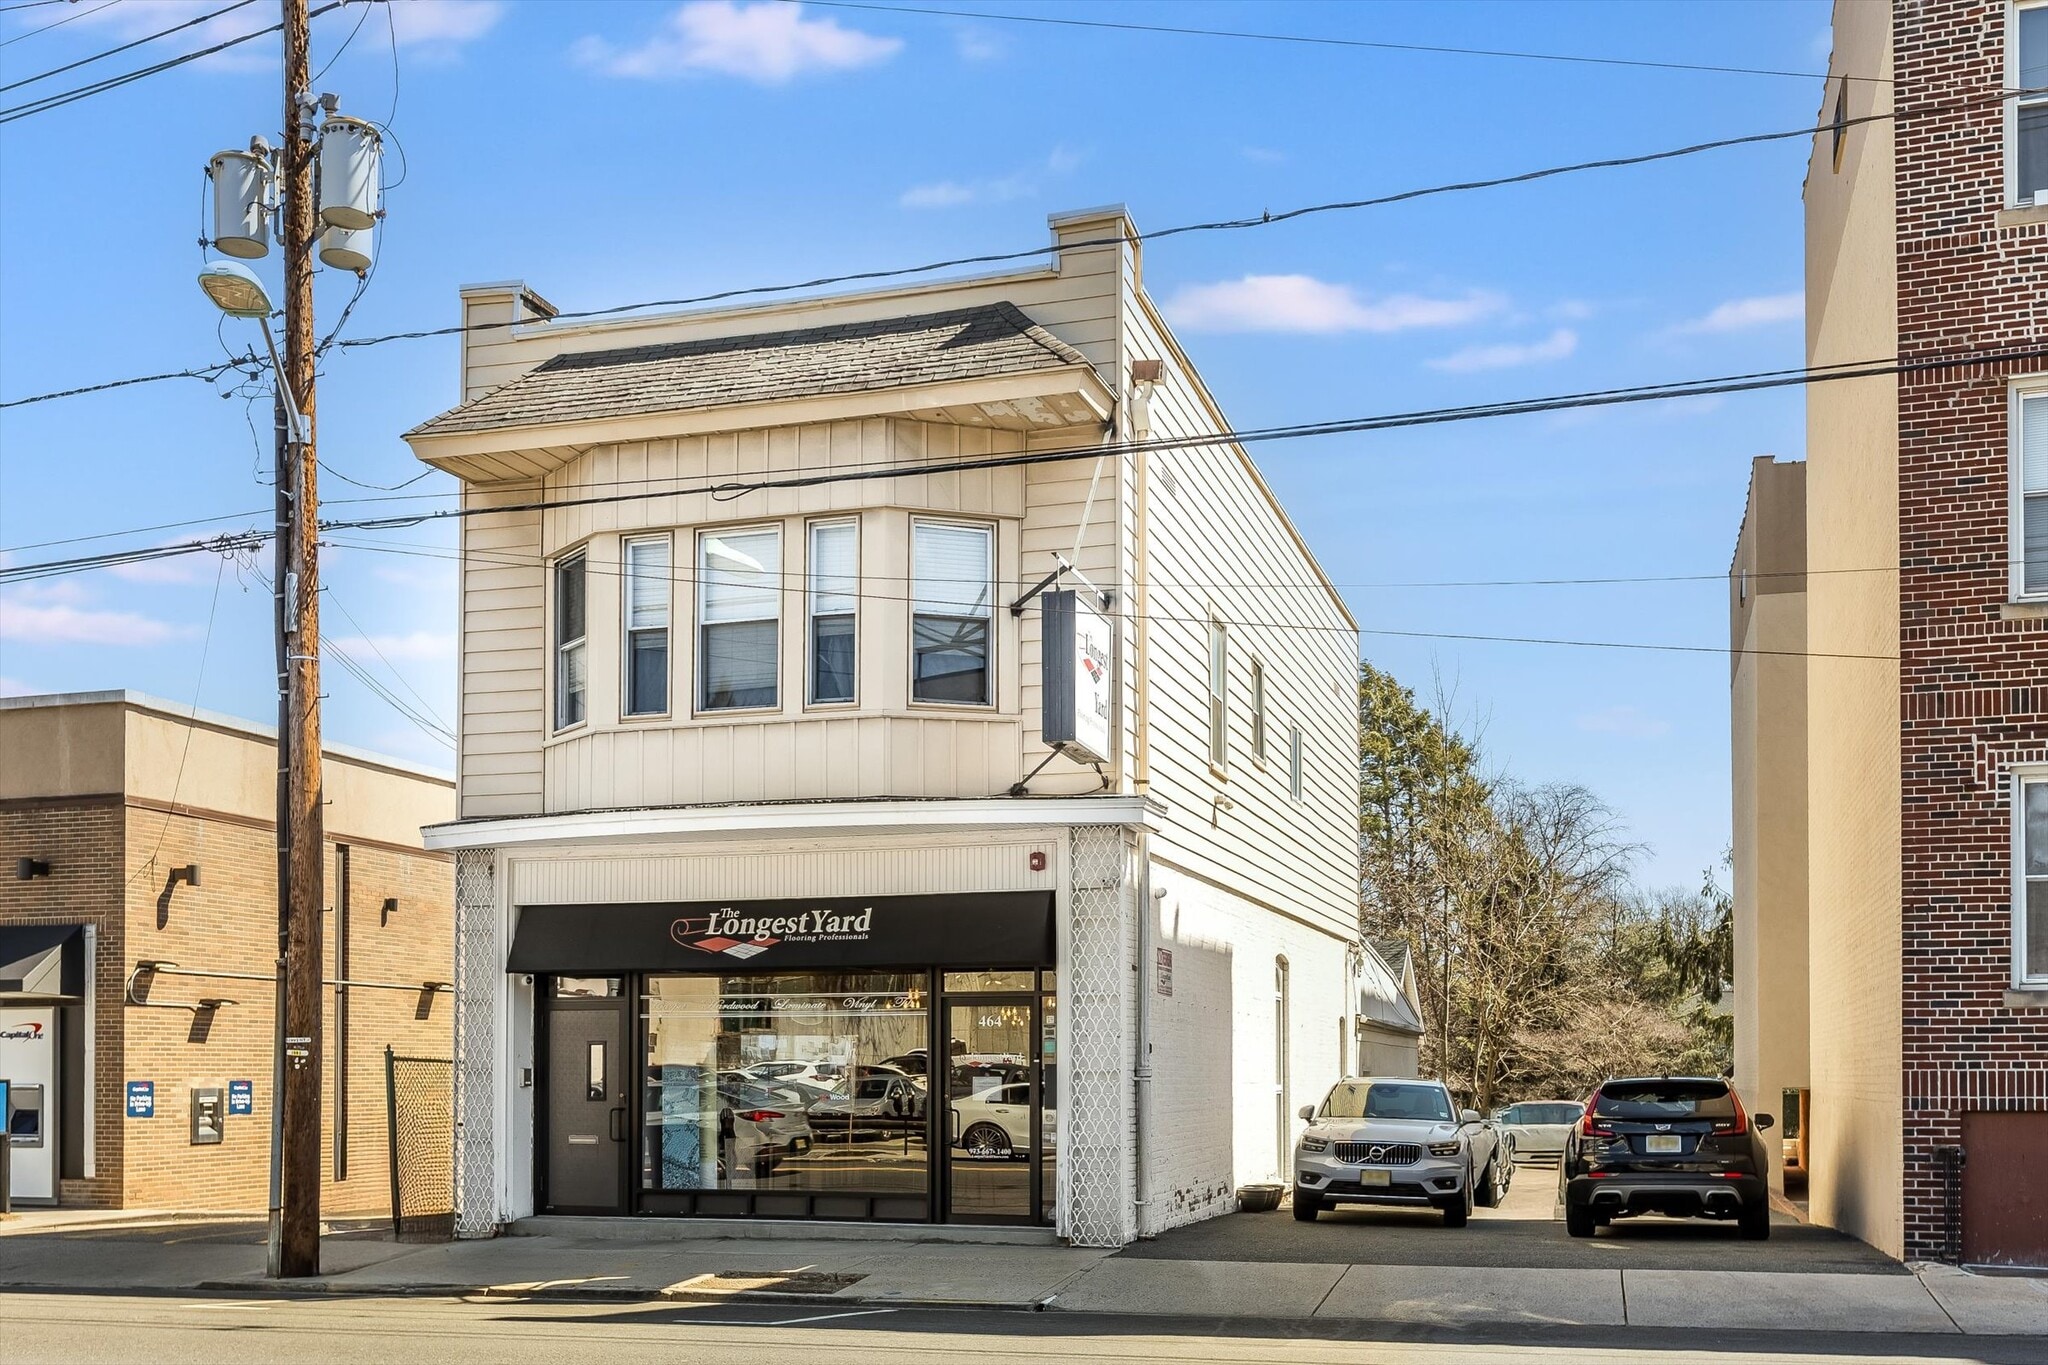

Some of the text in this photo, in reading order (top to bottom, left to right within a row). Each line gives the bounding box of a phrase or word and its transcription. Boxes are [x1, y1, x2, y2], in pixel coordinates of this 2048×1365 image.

[1085, 633, 1108, 671] Longest
[1094, 692, 1107, 720] Yard
[720, 907, 740, 918] The
[705, 907, 873, 941] Longest Yard
[784, 933, 869, 943] Flooring Professionals
[772, 998, 827, 1010] Laminate
[842, 996, 876, 1013] Vinyl
[978, 1015, 1002, 1027] 464
